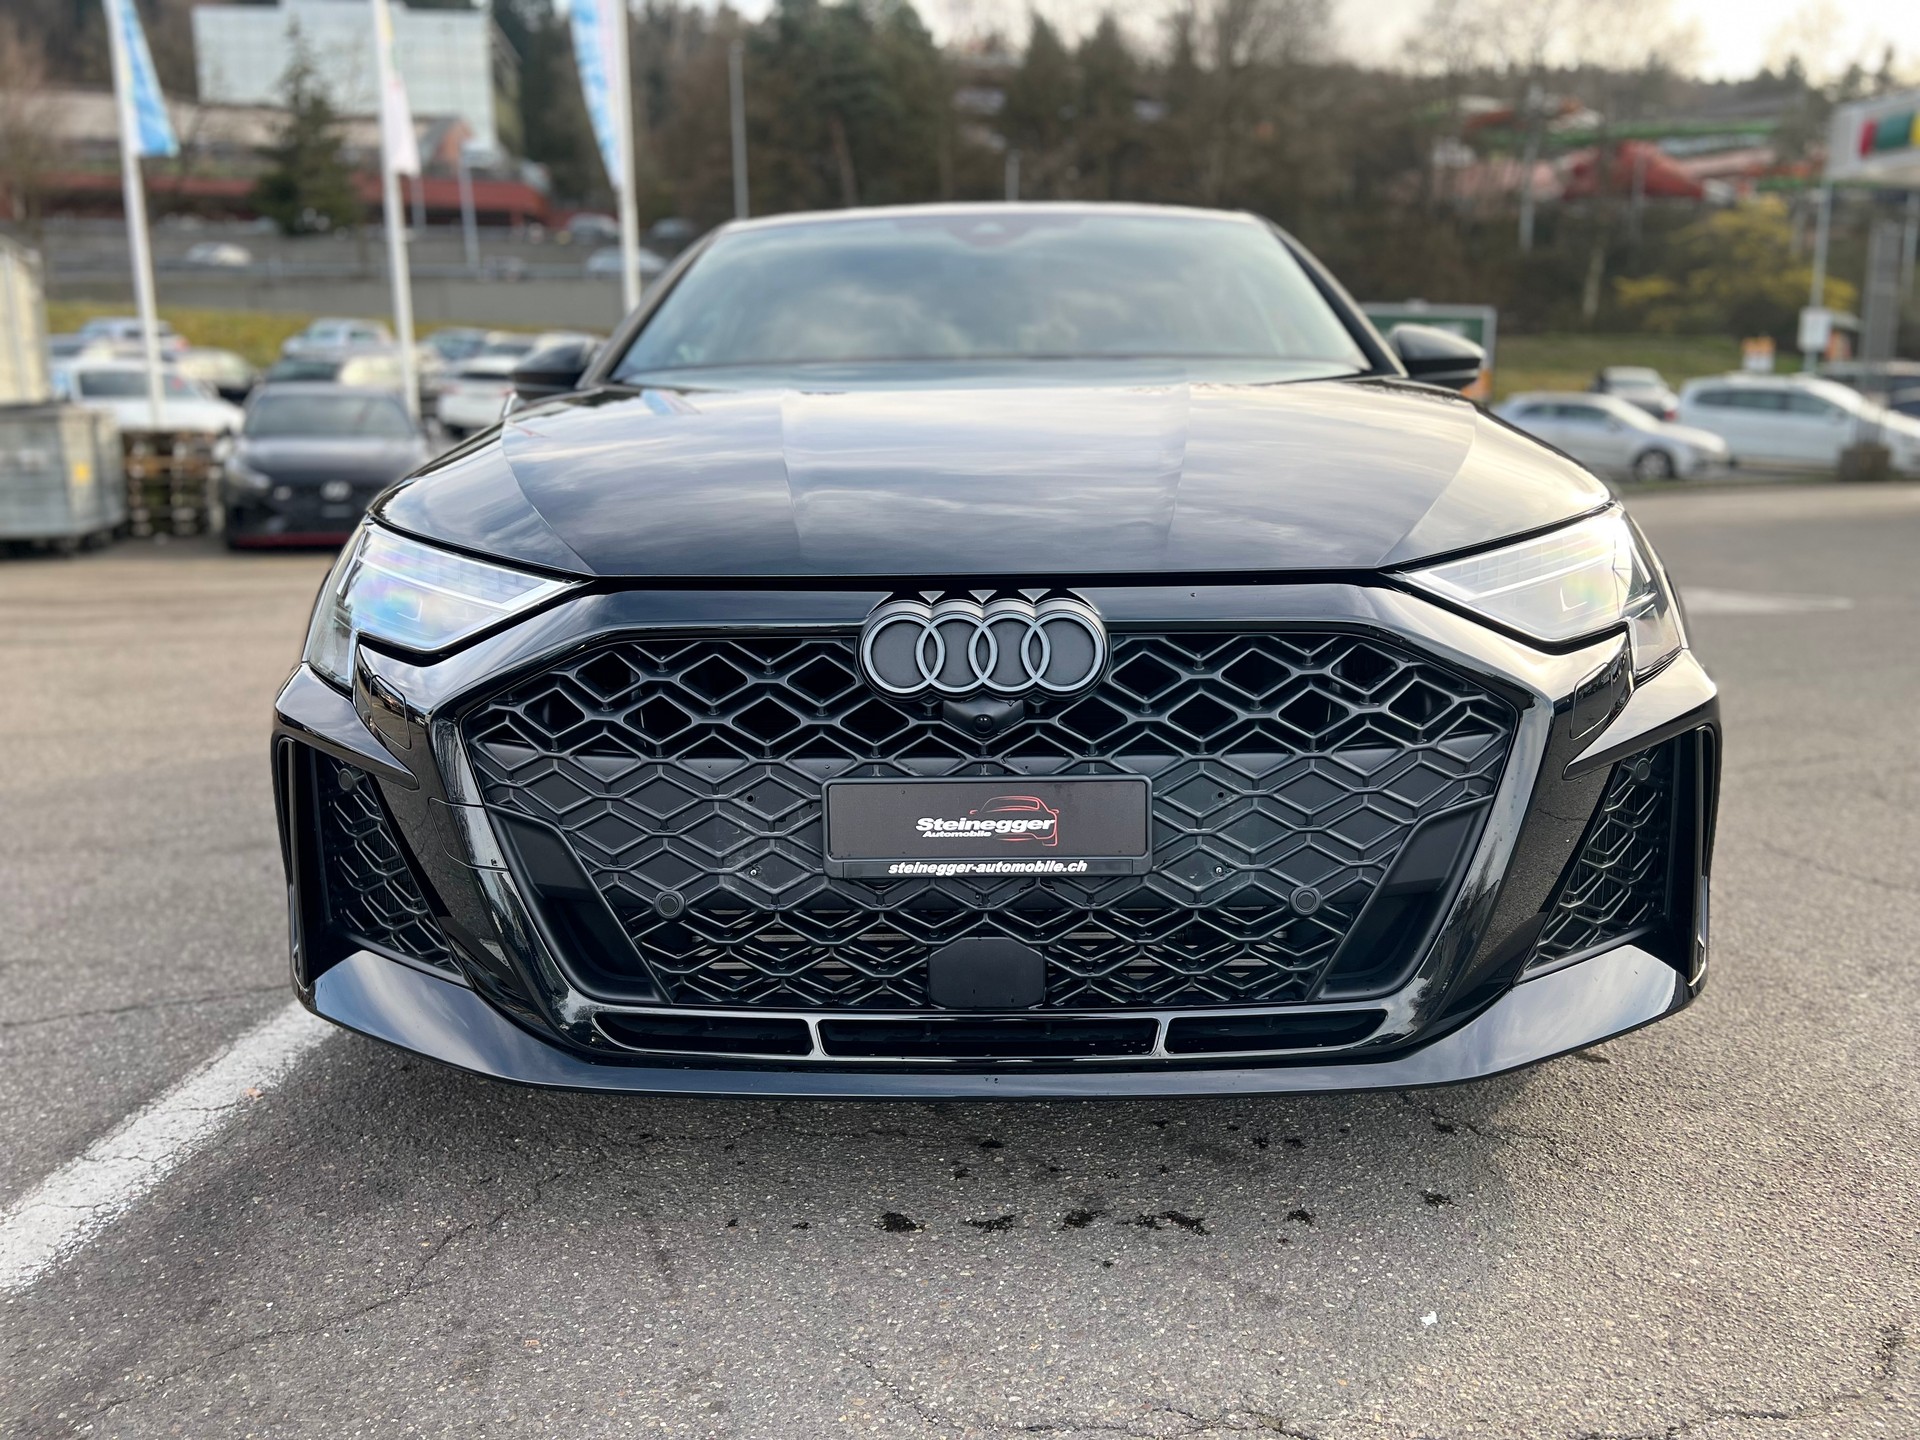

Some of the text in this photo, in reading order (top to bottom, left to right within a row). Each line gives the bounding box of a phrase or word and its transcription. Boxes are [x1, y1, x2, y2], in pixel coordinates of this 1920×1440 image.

[915, 817, 1055, 833] Steinegger
[922, 830, 992, 838] Automobile
[888, 860, 1088, 876] steinegger-automobile.ch
